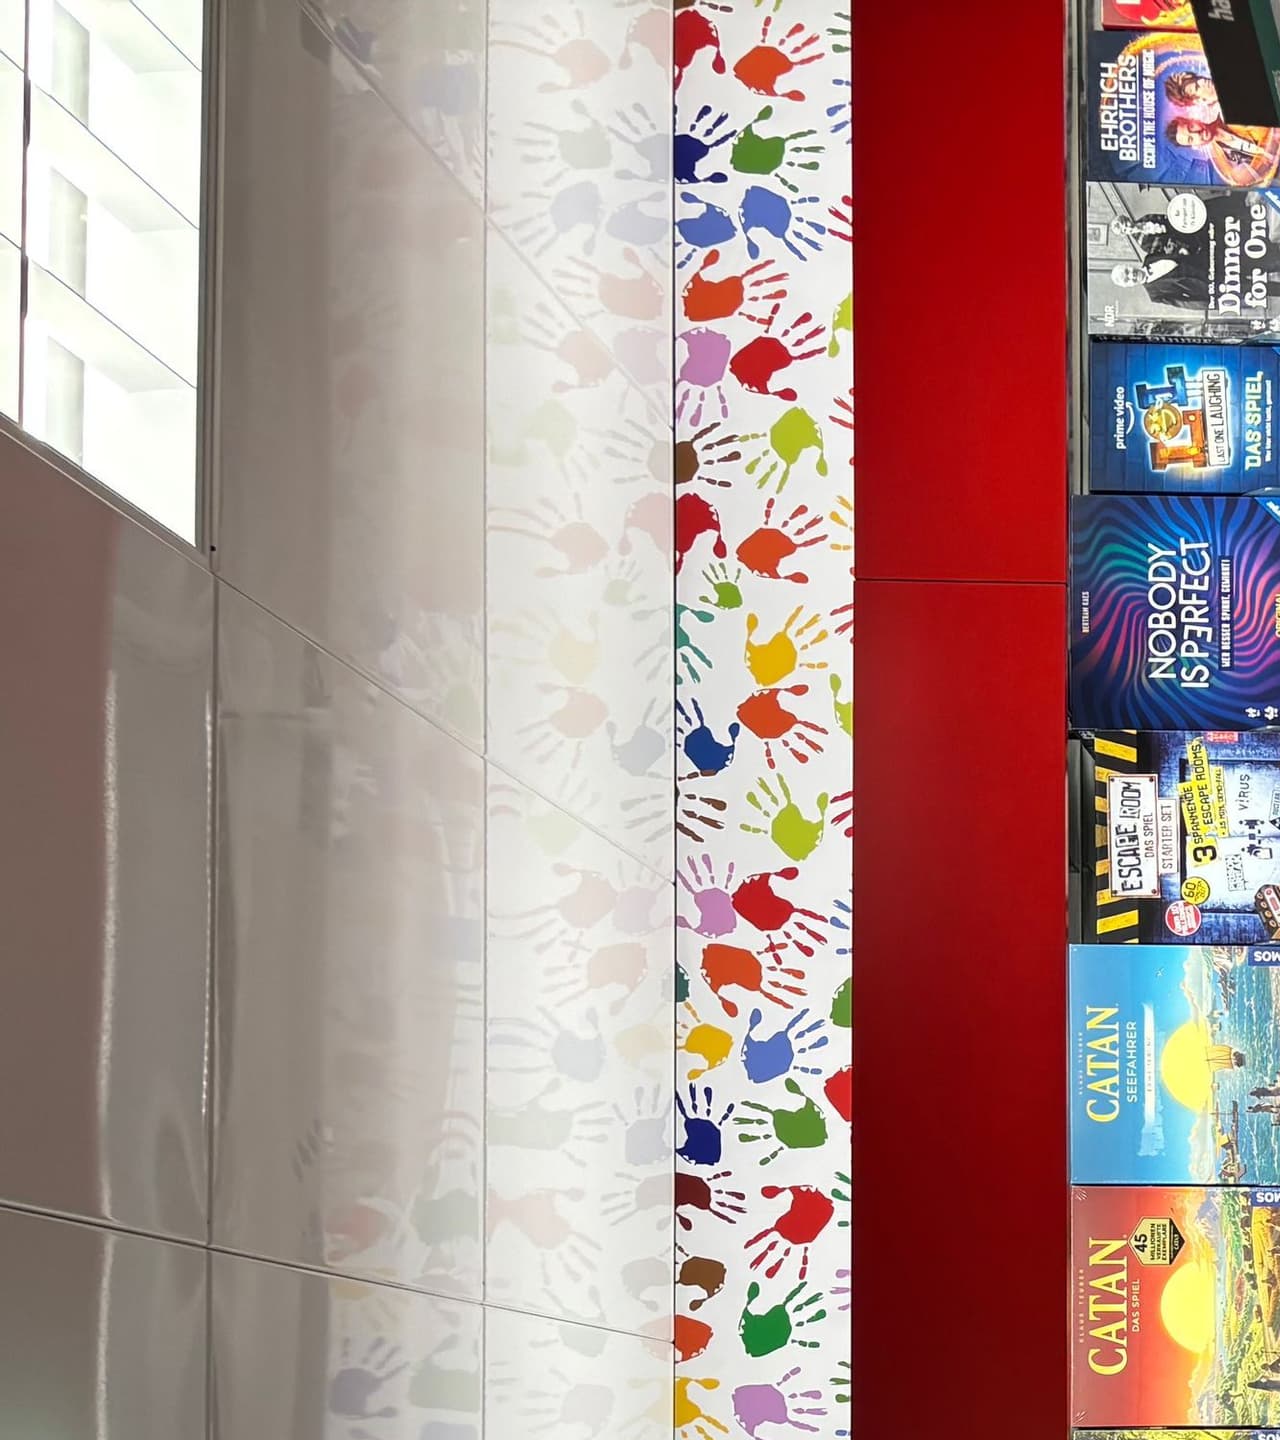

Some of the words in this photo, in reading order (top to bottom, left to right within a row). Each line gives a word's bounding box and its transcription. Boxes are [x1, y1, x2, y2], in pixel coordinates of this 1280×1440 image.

[1143, 49, 1154, 76] MAGIC
[1143, 78, 1154, 89] OF
[1100, 62, 1118, 150] EHRLICH
[1119, 54, 1136, 161] BROTHERS
[1143, 91, 1155, 119] HOUSE
[1143, 121, 1155, 136] THE
[1143, 138, 1156, 168] ESCAPE
[1244, 204, 1267, 259] One
[1218, 216, 1241, 315] Dinner
[1245, 268, 1267, 308] for
[1114, 387, 1124, 416] video
[1206, 373, 1223, 426] LAUGHING
[1114, 418, 1126, 449] prime
[1214, 429, 1224, 444] ONE
[1215, 445, 1226, 462] LAST
[1148, 543, 1177, 678] NOBODY
[1181, 665, 1209, 687] IS
[1191, 744, 1206, 781] ROOMS
[1119, 781, 1141, 818] ROOM
[1161, 804, 1172, 822] SET
[1198, 784, 1213, 825] ESCAPE
[1143, 813, 1153, 836] SPIEL
[1116, 824, 1142, 891] ESCAPE
[1144, 840, 1154, 858] DAS
[1161, 826, 1173, 869] STARTER
[1186, 883, 1196, 898] 60
[1086, 1005, 1120, 1123] CATAN
[1127, 1022, 1136, 1103] SEEFAHRER
[1135, 1234, 1147, 1253] 45
[1088, 1237, 1128, 1375] CATAN
[1132, 1279, 1140, 1307] SPIEL
[1132, 1311, 1140, 1332] DAS
